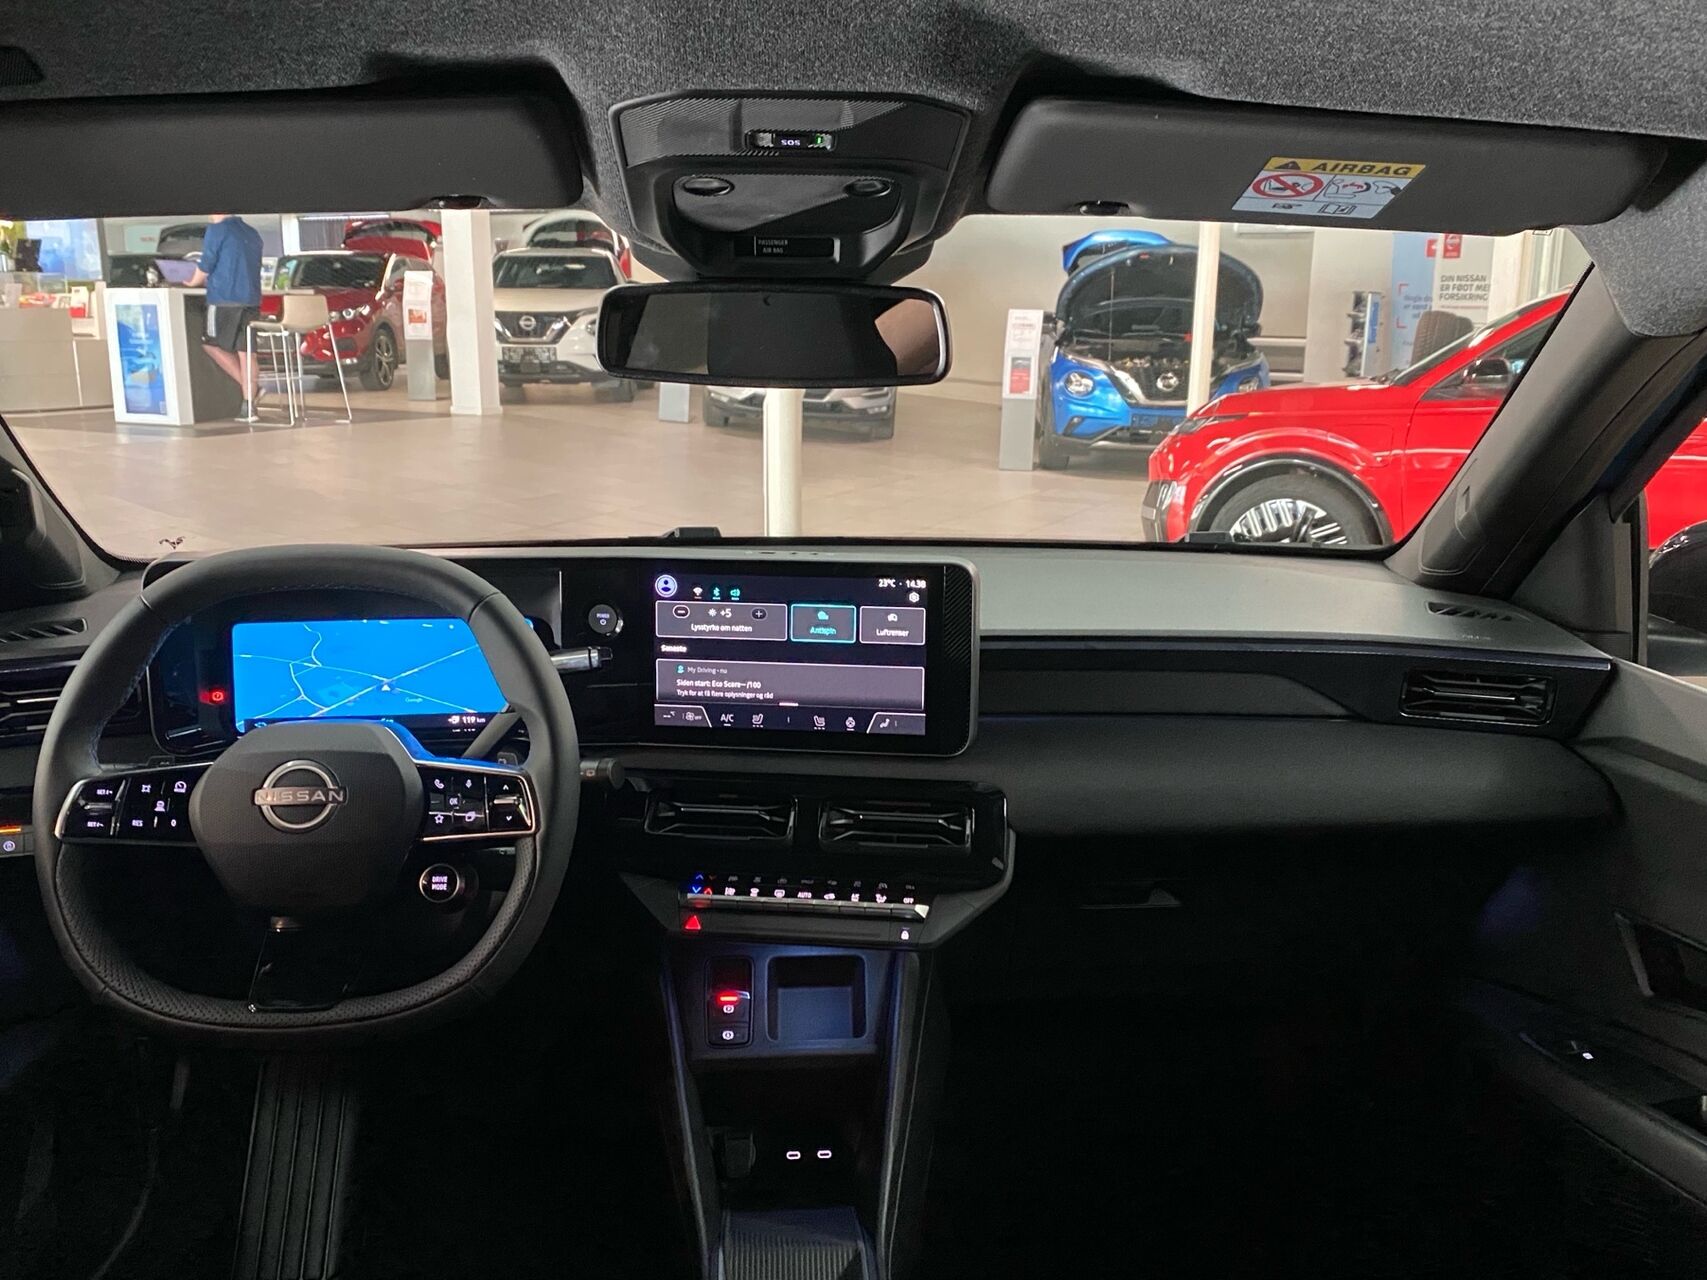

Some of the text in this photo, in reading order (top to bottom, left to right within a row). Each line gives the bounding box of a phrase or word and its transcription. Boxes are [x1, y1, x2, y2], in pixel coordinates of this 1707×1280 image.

[1312, 162, 1411, 176] AIRBAG
[1440, 274, 1487, 282] DIN NISSAN
[1440, 283, 1451, 291] ER
[1452, 283, 1474, 291] FØDT
[731, 624, 753, 633] natten
[687, 666, 696, 674] My
[697, 667, 716, 675] Driving
[676, 679, 694, 687] Siden
[711, 680, 723, 688] Eco
[676, 689, 689, 698] Tryk
[724, 691, 756, 700] oplysninger
[462, 715, 476, 724] 119
[720, 713, 735, 723] A/C
[258, 790, 344, 802] NISSAN
[449, 797, 459, 806] OK
[131, 819, 143, 827] RES
[431, 883, 448, 891] MODE
[797, 891, 812, 899] AUTO
